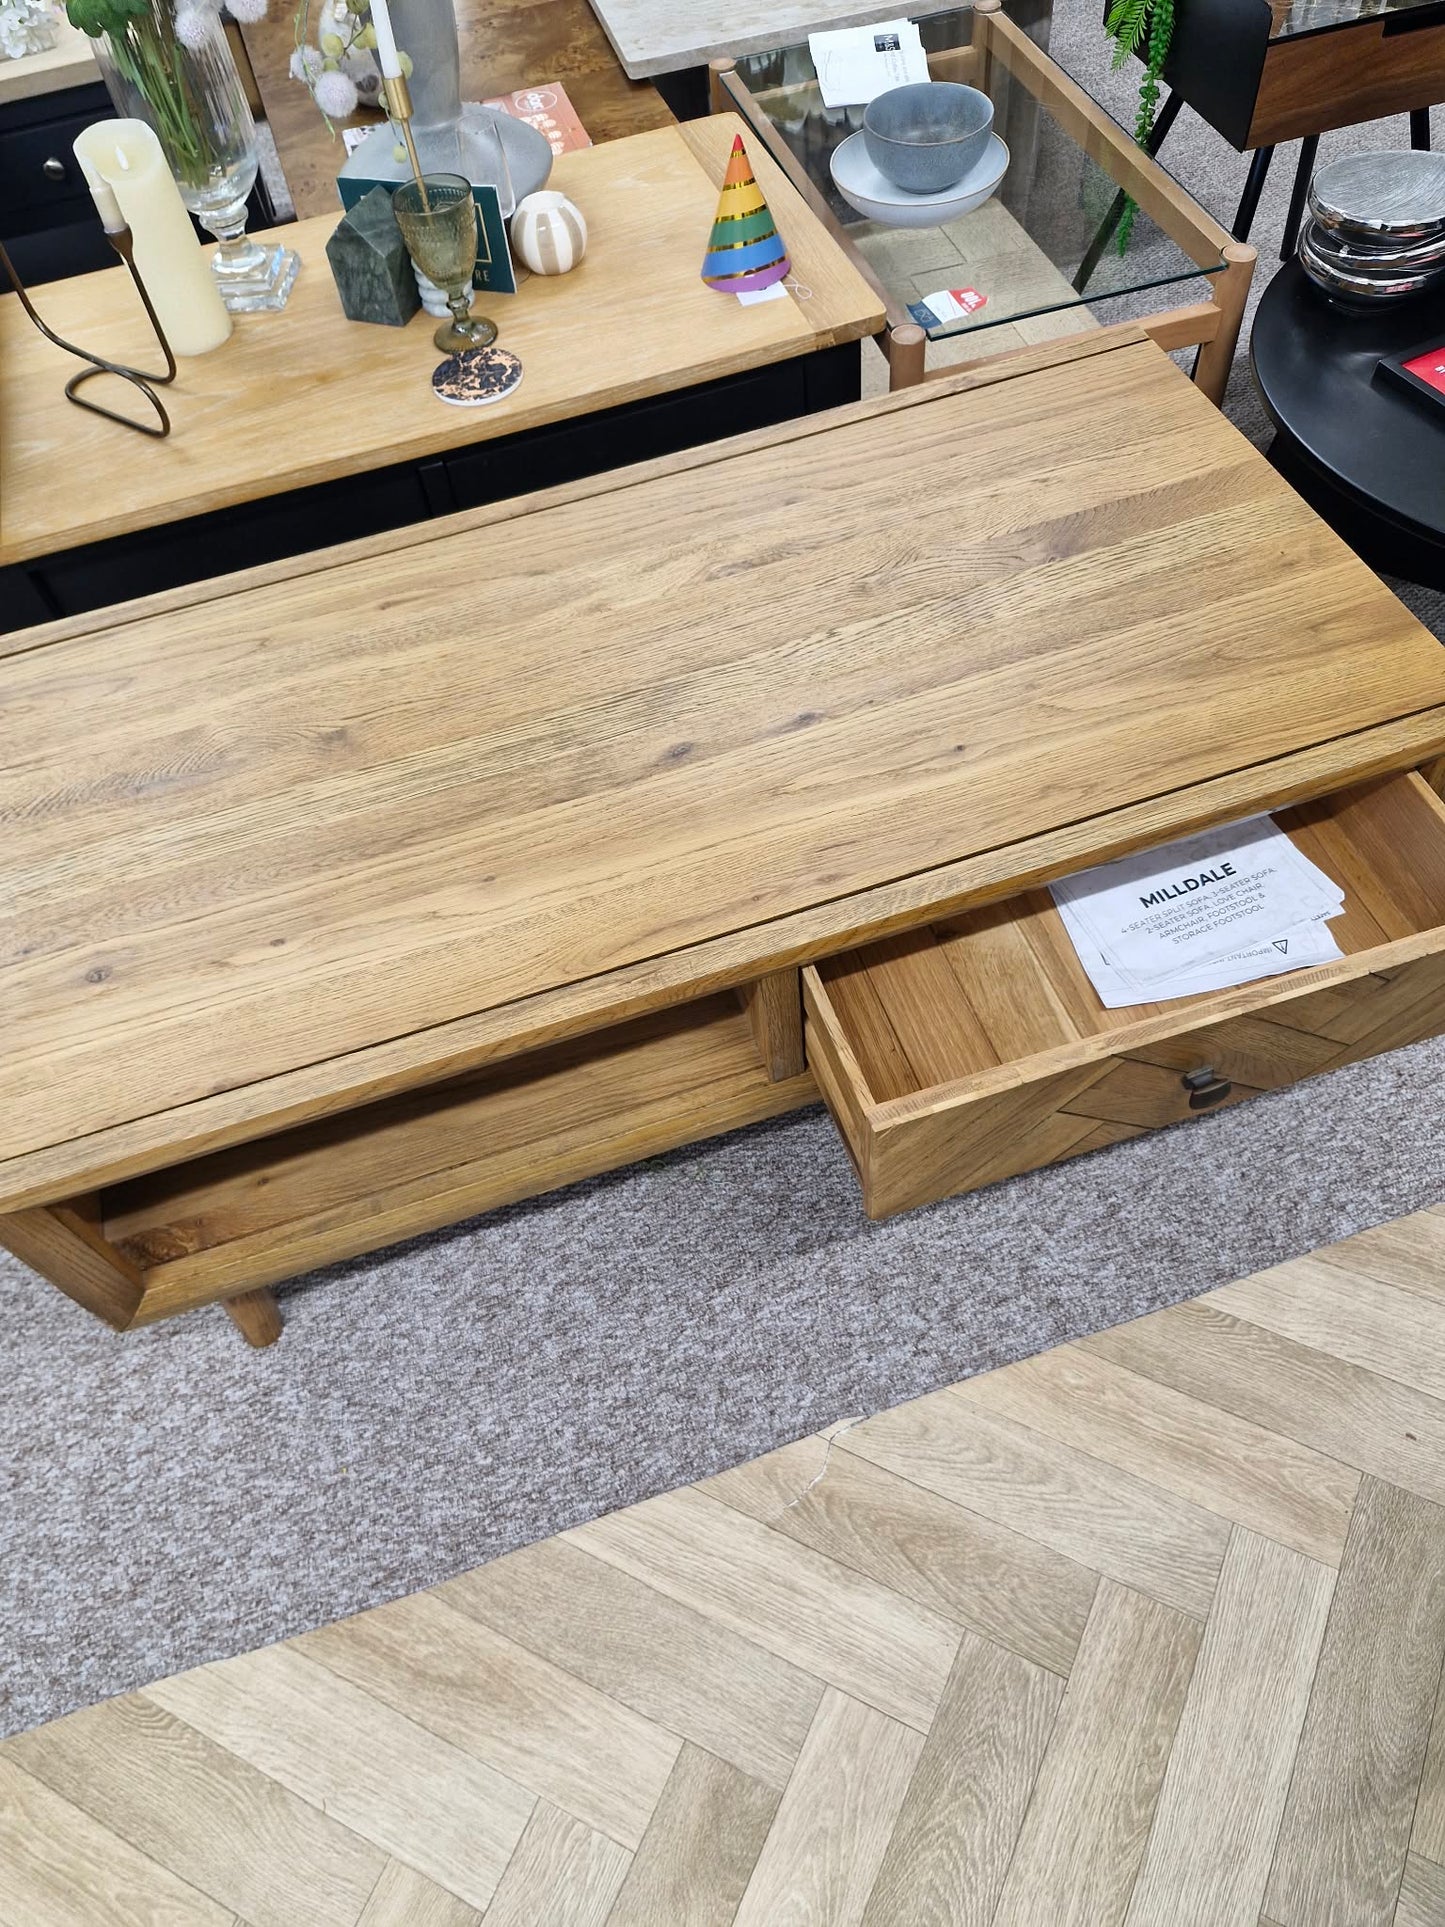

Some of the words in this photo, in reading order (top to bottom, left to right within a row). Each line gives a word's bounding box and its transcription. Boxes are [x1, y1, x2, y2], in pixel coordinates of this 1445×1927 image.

[1121, 913, 1162, 934] 4-SEATER
[1163, 904, 1185, 918] SPLIT
[1212, 877, 1251, 898] 3-SEATER
[1139, 862, 1237, 909] MILLDALE
[1207, 895, 1259, 919] FOOTSTOOL
[1145, 913, 1186, 934] 2-SEATER
[1213, 891, 1236, 906] LOVE
[1172, 924, 1214, 945] STORAGE
[1214, 904, 1266, 926] FOOTSTOOL
